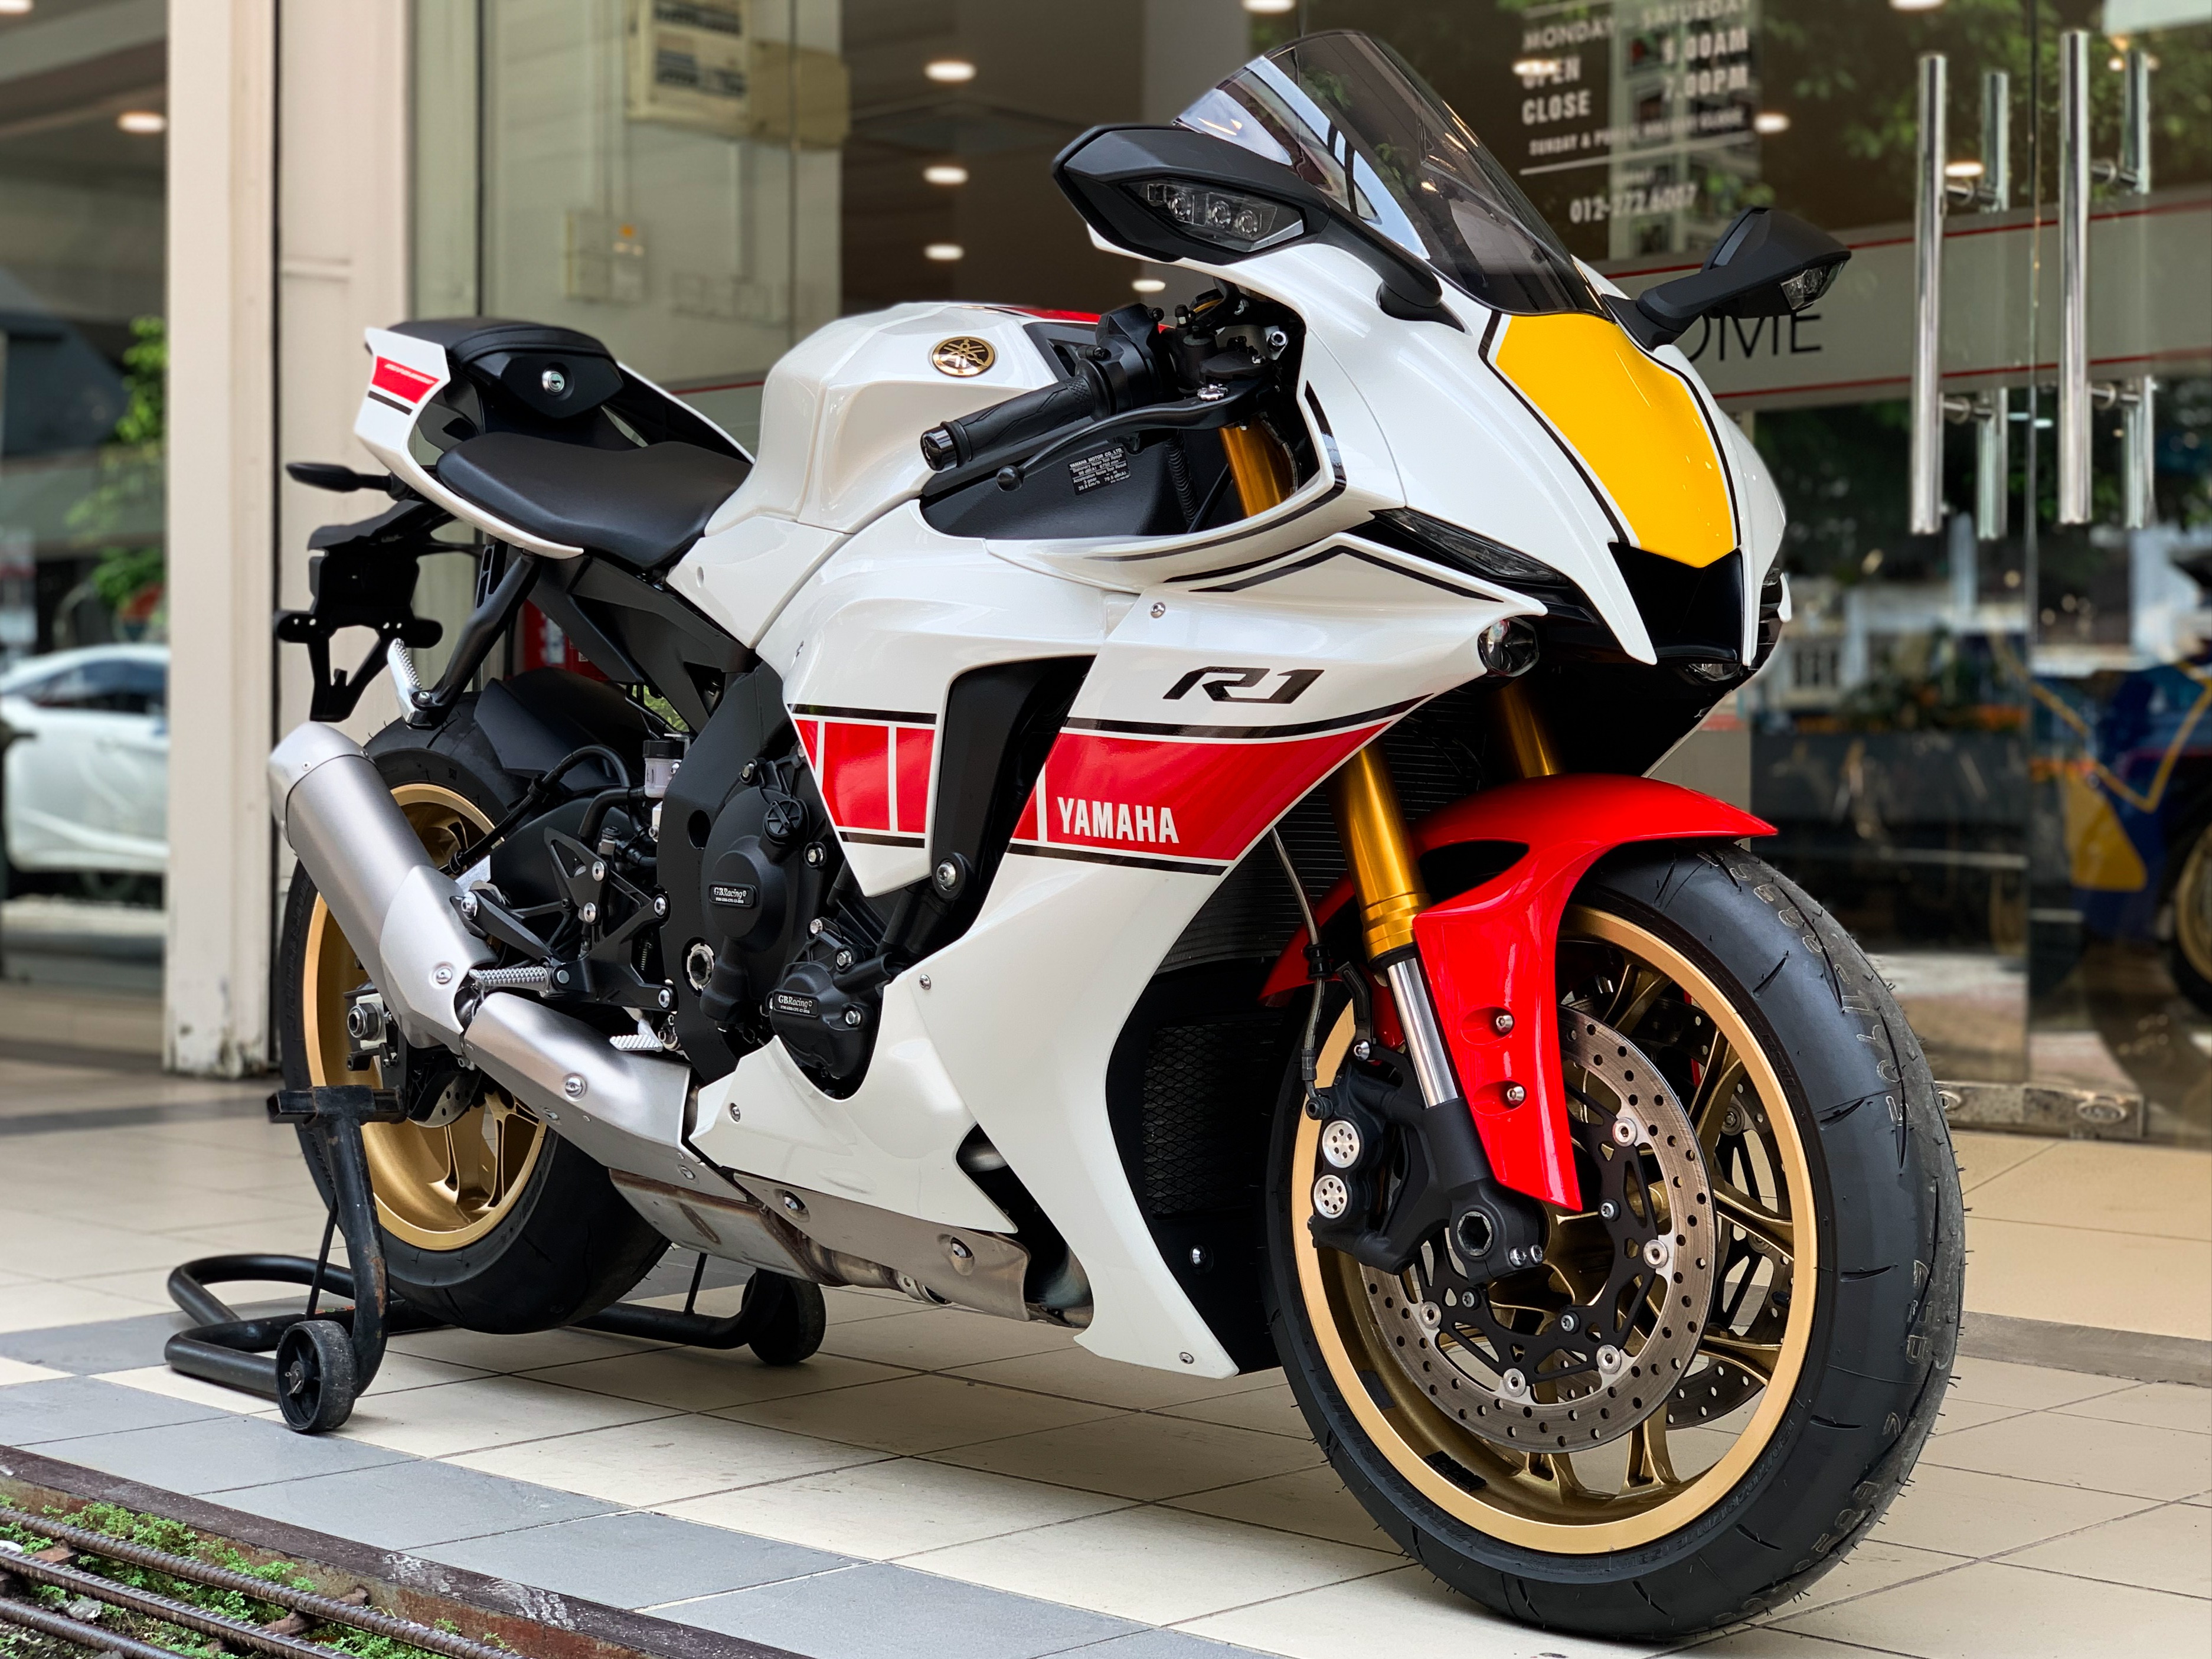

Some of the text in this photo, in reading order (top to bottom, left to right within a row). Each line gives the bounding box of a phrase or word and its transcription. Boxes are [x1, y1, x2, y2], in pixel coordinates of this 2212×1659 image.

[1523, 17, 1613, 51] MONDAY
[1522, 91, 1592, 125] CLOSE
[1162, 666, 1325, 704] R1
[1057, 796, 1180, 844] YAMAHA
